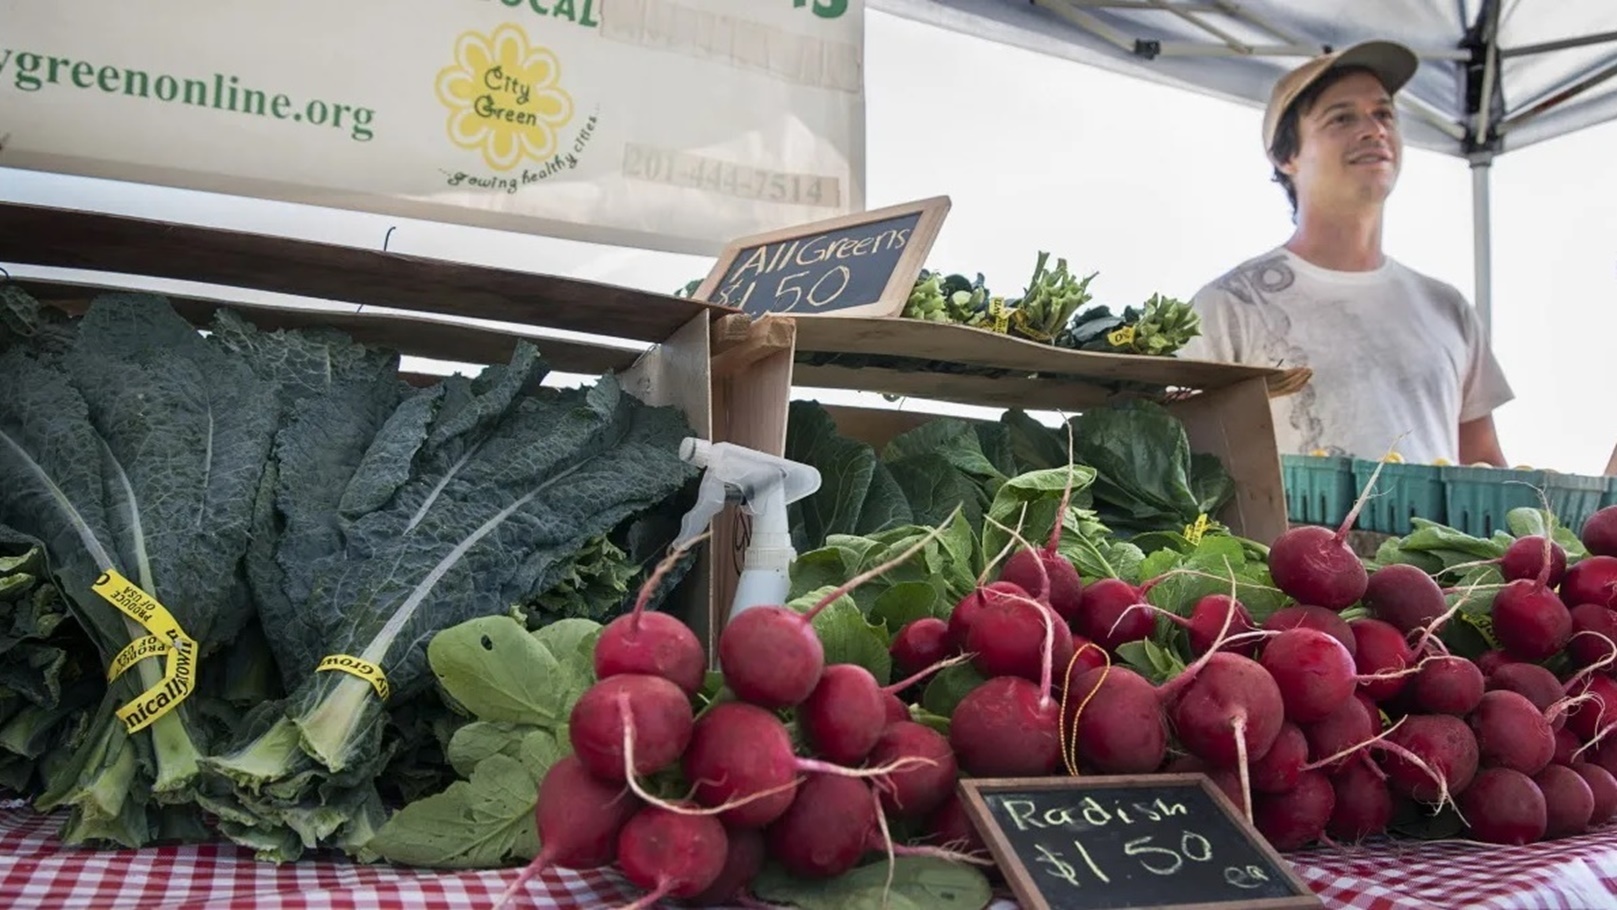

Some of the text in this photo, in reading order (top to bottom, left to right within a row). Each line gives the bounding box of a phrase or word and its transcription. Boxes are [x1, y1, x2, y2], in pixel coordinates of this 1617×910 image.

[484, 65, 530, 105] City
[474, 94, 537, 126] Green
[521, 150, 578, 184] healthy
[626, 147, 824, 203] 201-444-7514
[110, 590, 153, 622] PRODUCE
[123, 586, 156, 611] OF USA
[1003, 796, 1188, 831] Radish
[1035, 830, 1213, 886] $1.50
